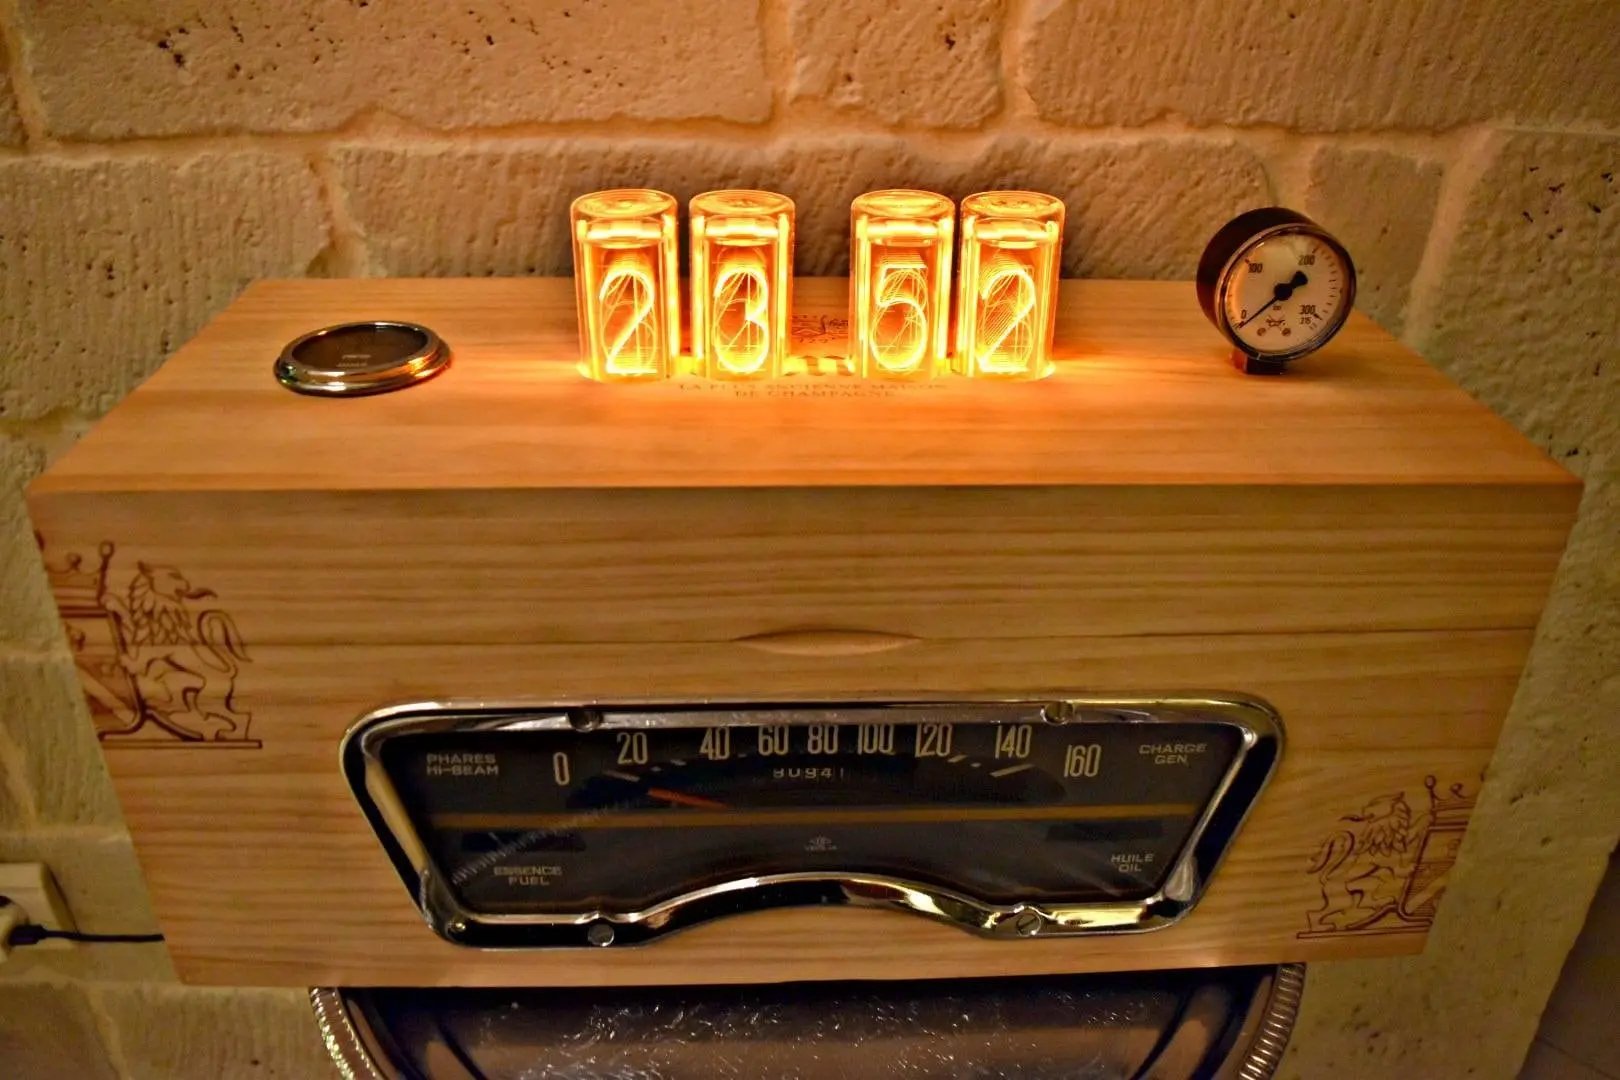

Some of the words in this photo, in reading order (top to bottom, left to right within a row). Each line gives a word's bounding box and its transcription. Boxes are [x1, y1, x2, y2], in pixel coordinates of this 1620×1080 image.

[1298, 255, 1315, 265] 200
[1249, 263, 1263, 273] 100
[1241, 309, 1247, 319] 0
[1300, 304, 1316, 314] 300
[699, 726, 731, 760] 40
[758, 724, 790, 756] 60
[807, 723, 839, 755] 80
[856, 723, 895, 755] 100
[914, 723, 953, 758] 120
[994, 724, 1032, 759] 140
[616, 732, 649, 765] 20
[1139, 743, 1207, 754] CHARGE
[426, 753, 497, 764] PHARES
[1063, 744, 1101, 777] 160
[426, 765, 499, 775] HI-BEAM
[553, 751, 571, 786] 0
[1111, 853, 1154, 863] HUILE
[493, 865, 562, 875] ESSENCE
[1118, 863, 1143, 873] OIL
[508, 876, 550, 885] FUEL
